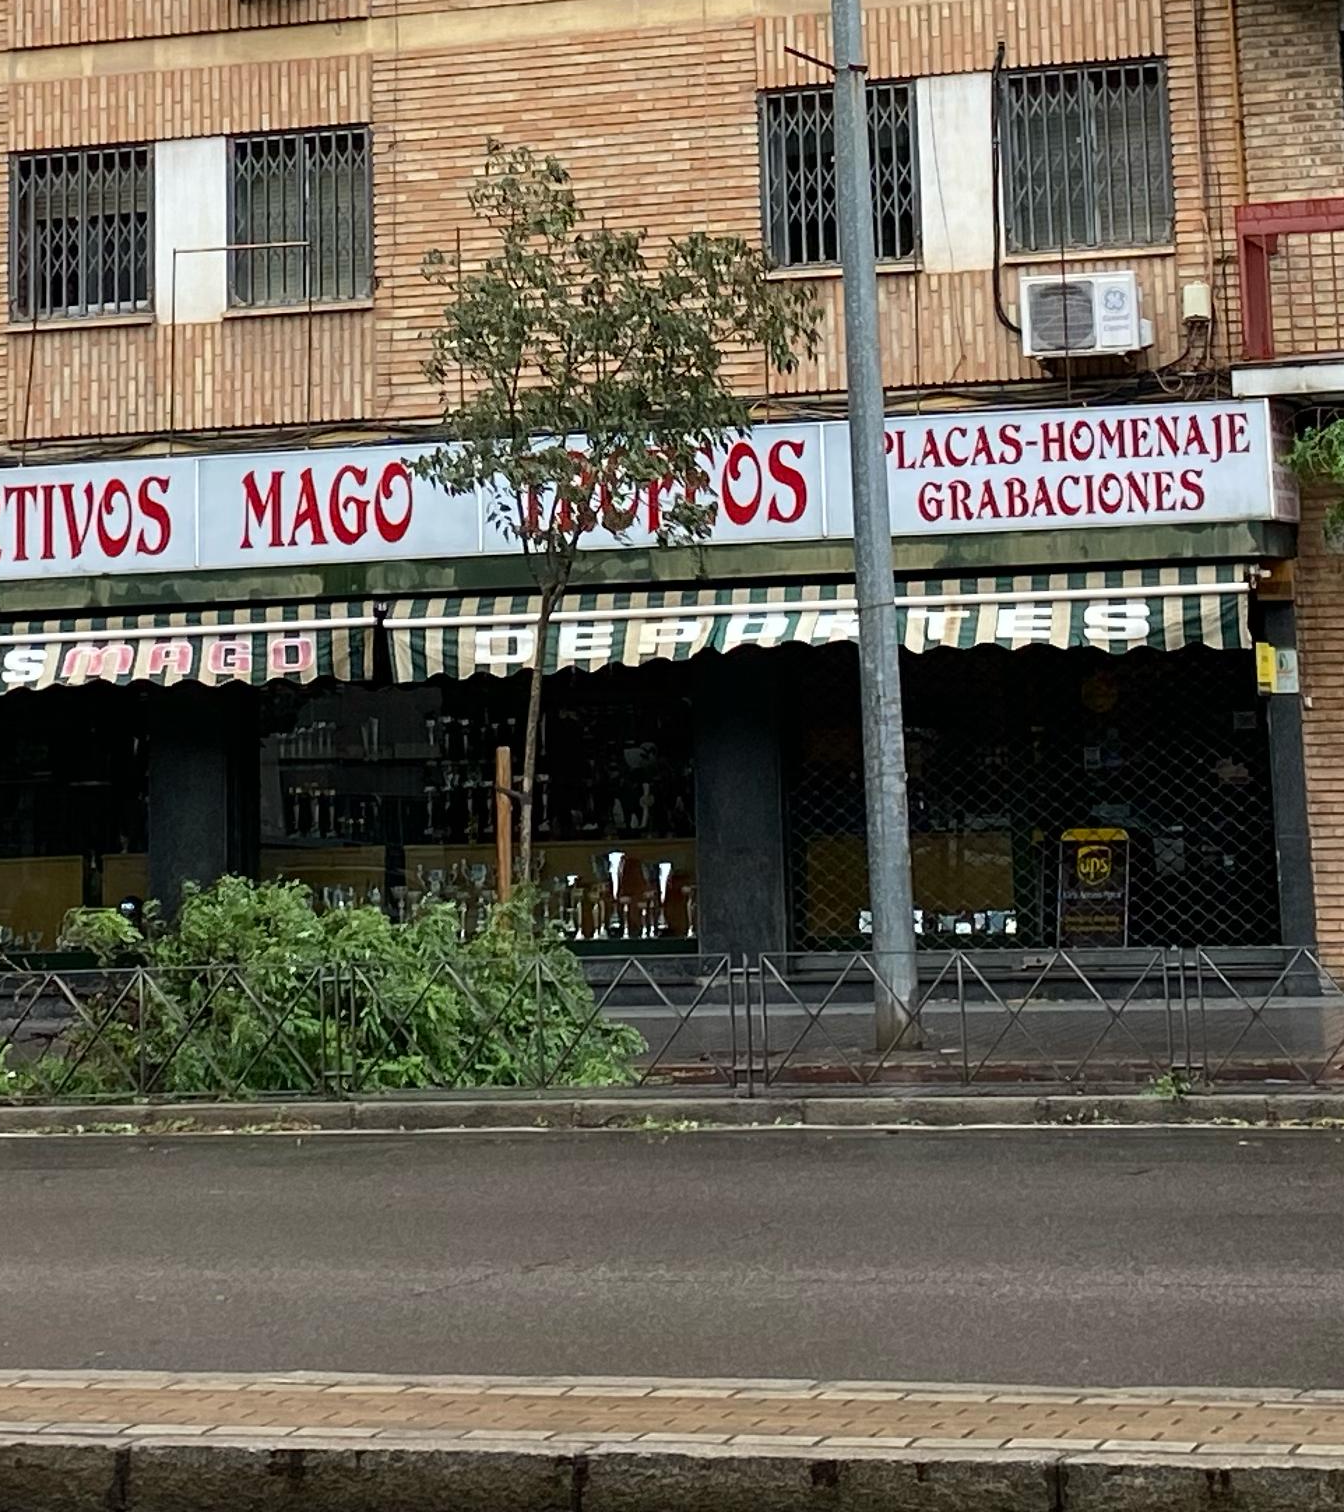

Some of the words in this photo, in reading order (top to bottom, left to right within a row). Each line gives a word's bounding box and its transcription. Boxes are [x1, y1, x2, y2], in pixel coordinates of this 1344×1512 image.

[240, 461, 413, 550] MAGO
[918, 469, 1206, 522] GRABACIONES
[60, 637, 313, 680] MAGO
[474, 604, 1151, 664] DEPORTES
[1080, 857, 1109, 880] ups
